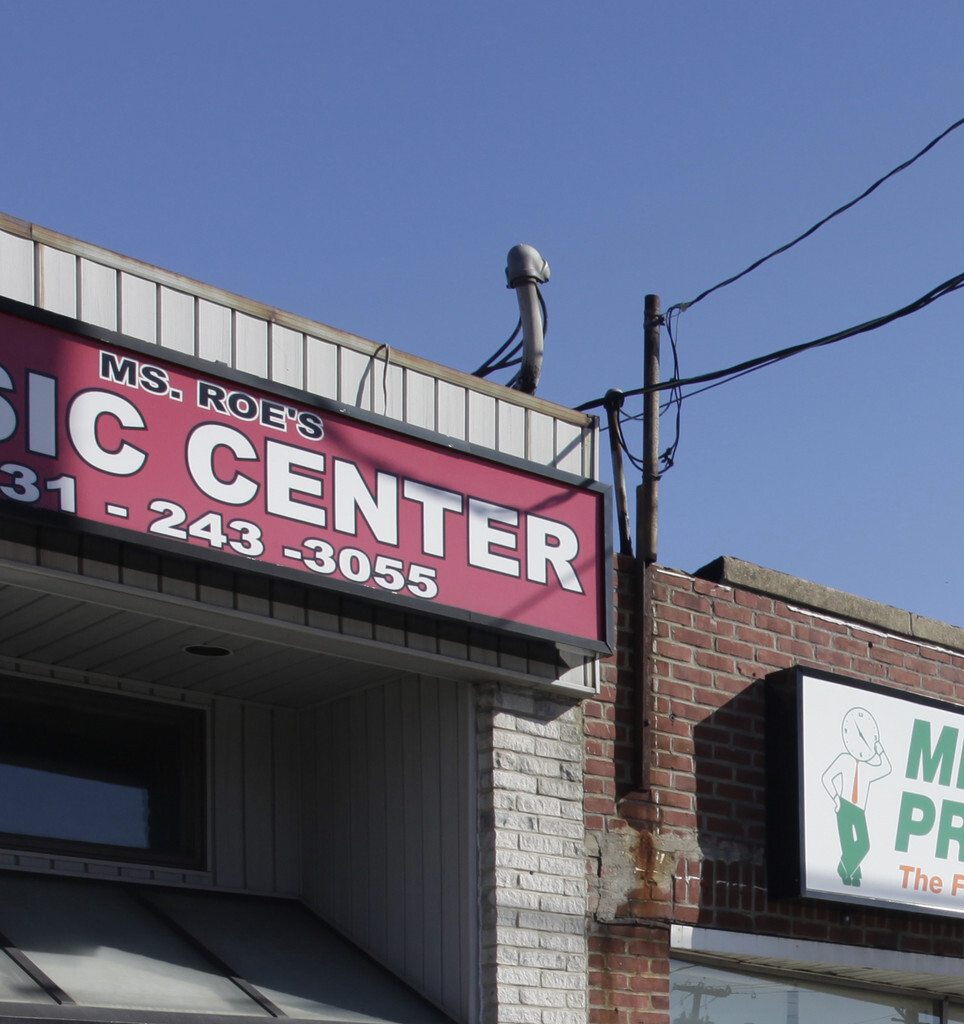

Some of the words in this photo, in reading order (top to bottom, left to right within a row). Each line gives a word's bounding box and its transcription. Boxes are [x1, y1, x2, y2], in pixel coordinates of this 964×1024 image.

[99, 350, 184, 403] MS.
[196, 379, 325, 441] ROE'S
[0, 361, 148, 477] IC
[184, 420, 585, 597] CENTER
[148, 499, 264, 558] 243
[899, 864, 944, 896] The
